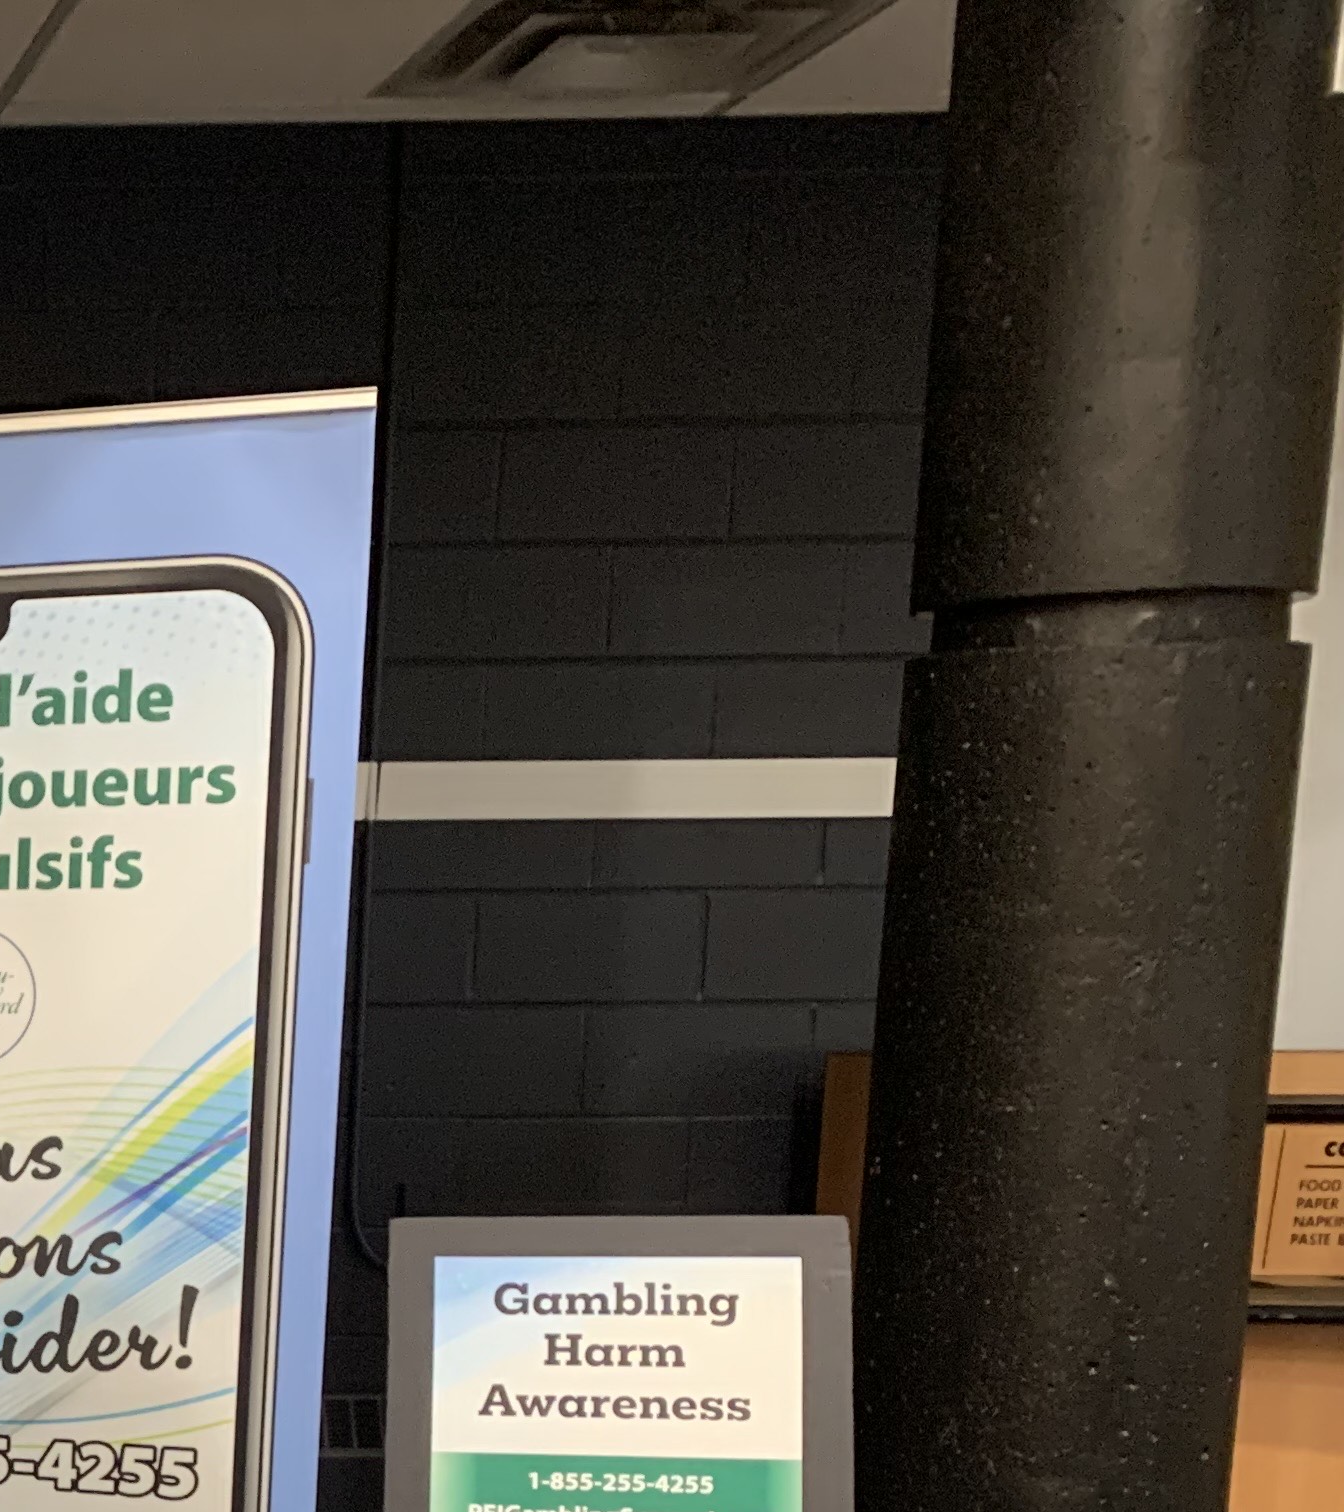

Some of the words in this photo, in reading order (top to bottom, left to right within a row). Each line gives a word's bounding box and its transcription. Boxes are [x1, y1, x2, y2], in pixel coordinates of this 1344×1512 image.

[1299, 1179, 1342, 1192] FOOD
[1296, 1197, 1339, 1210] PAPER
[1290, 1233, 1331, 1245] PASTE
[493, 1282, 739, 1327] Gambling
[543, 1333, 686, 1368] Harm
[477, 1383, 752, 1421] Awareness
[528, 1471, 714, 1495] 1-855-255-4255
